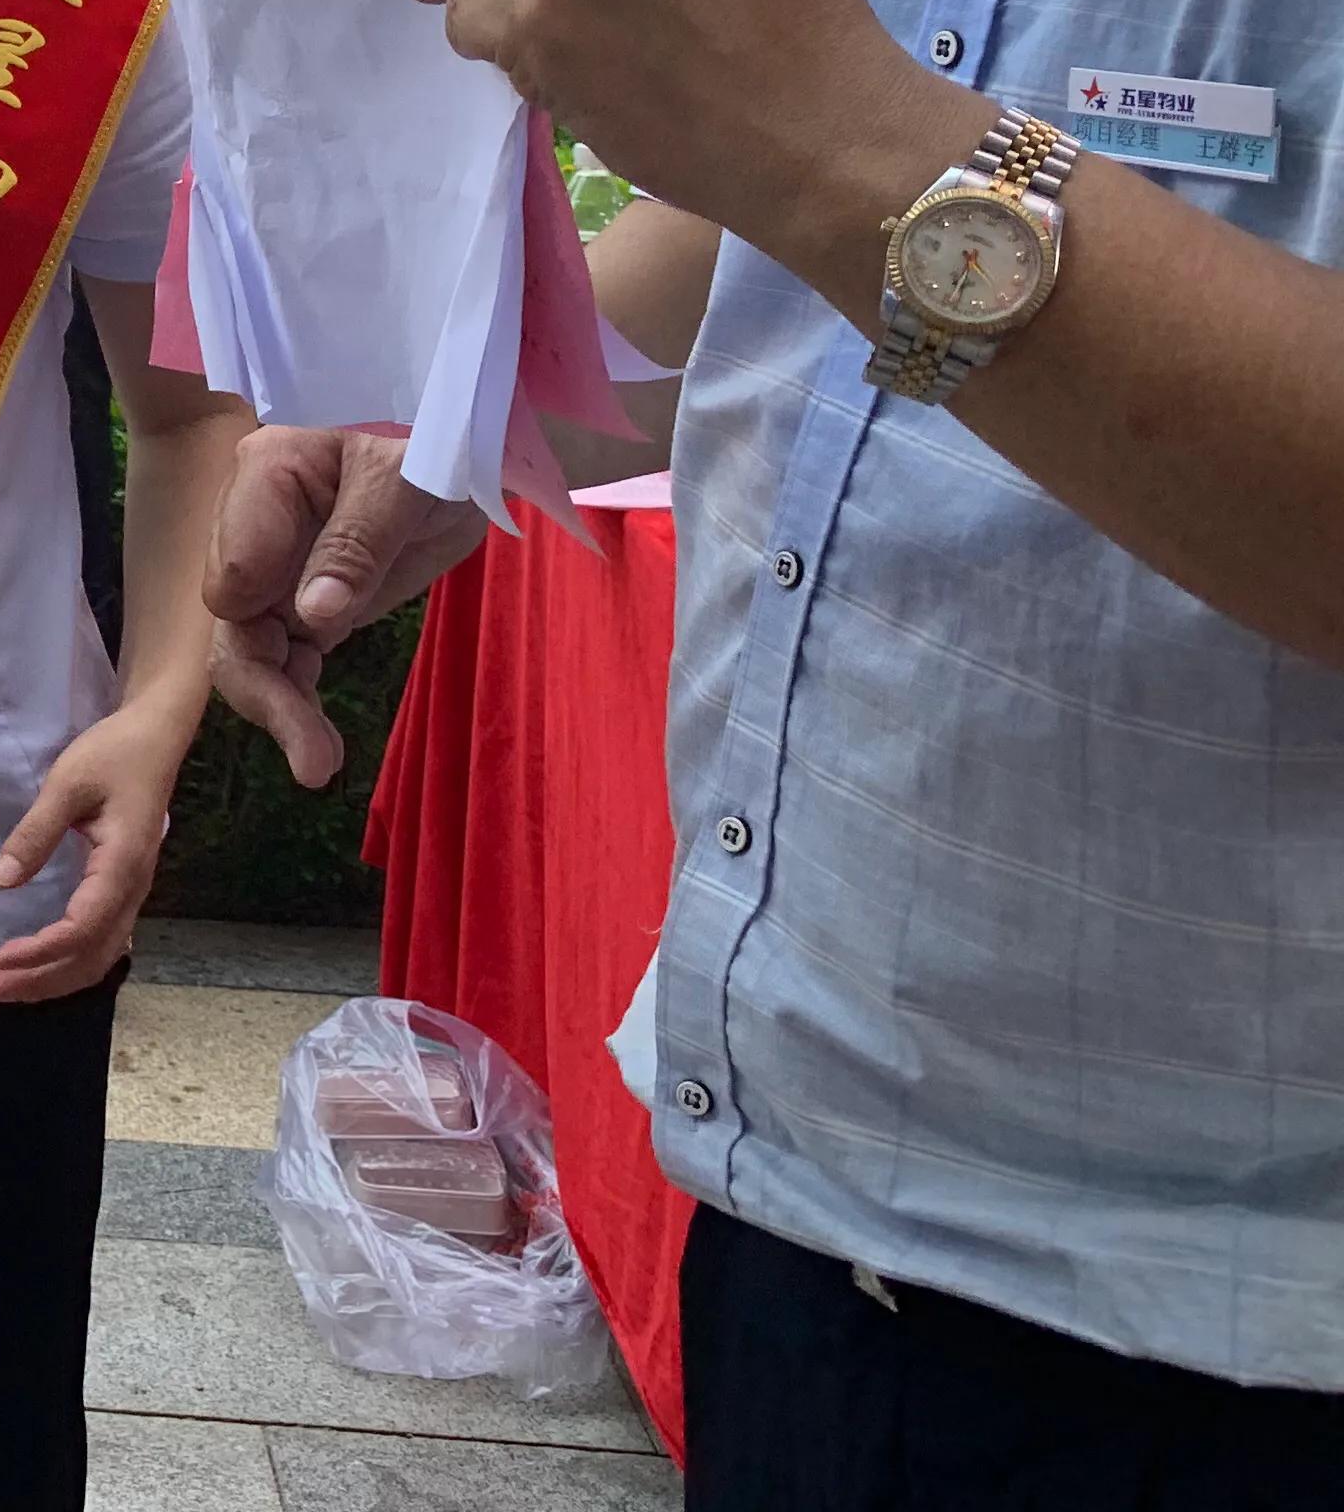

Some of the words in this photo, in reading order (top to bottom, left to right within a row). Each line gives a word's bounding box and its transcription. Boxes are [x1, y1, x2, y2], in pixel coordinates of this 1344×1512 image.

[1119, 87, 1195, 113] 五星物业
[1074, 115, 1162, 152] 项目经理
